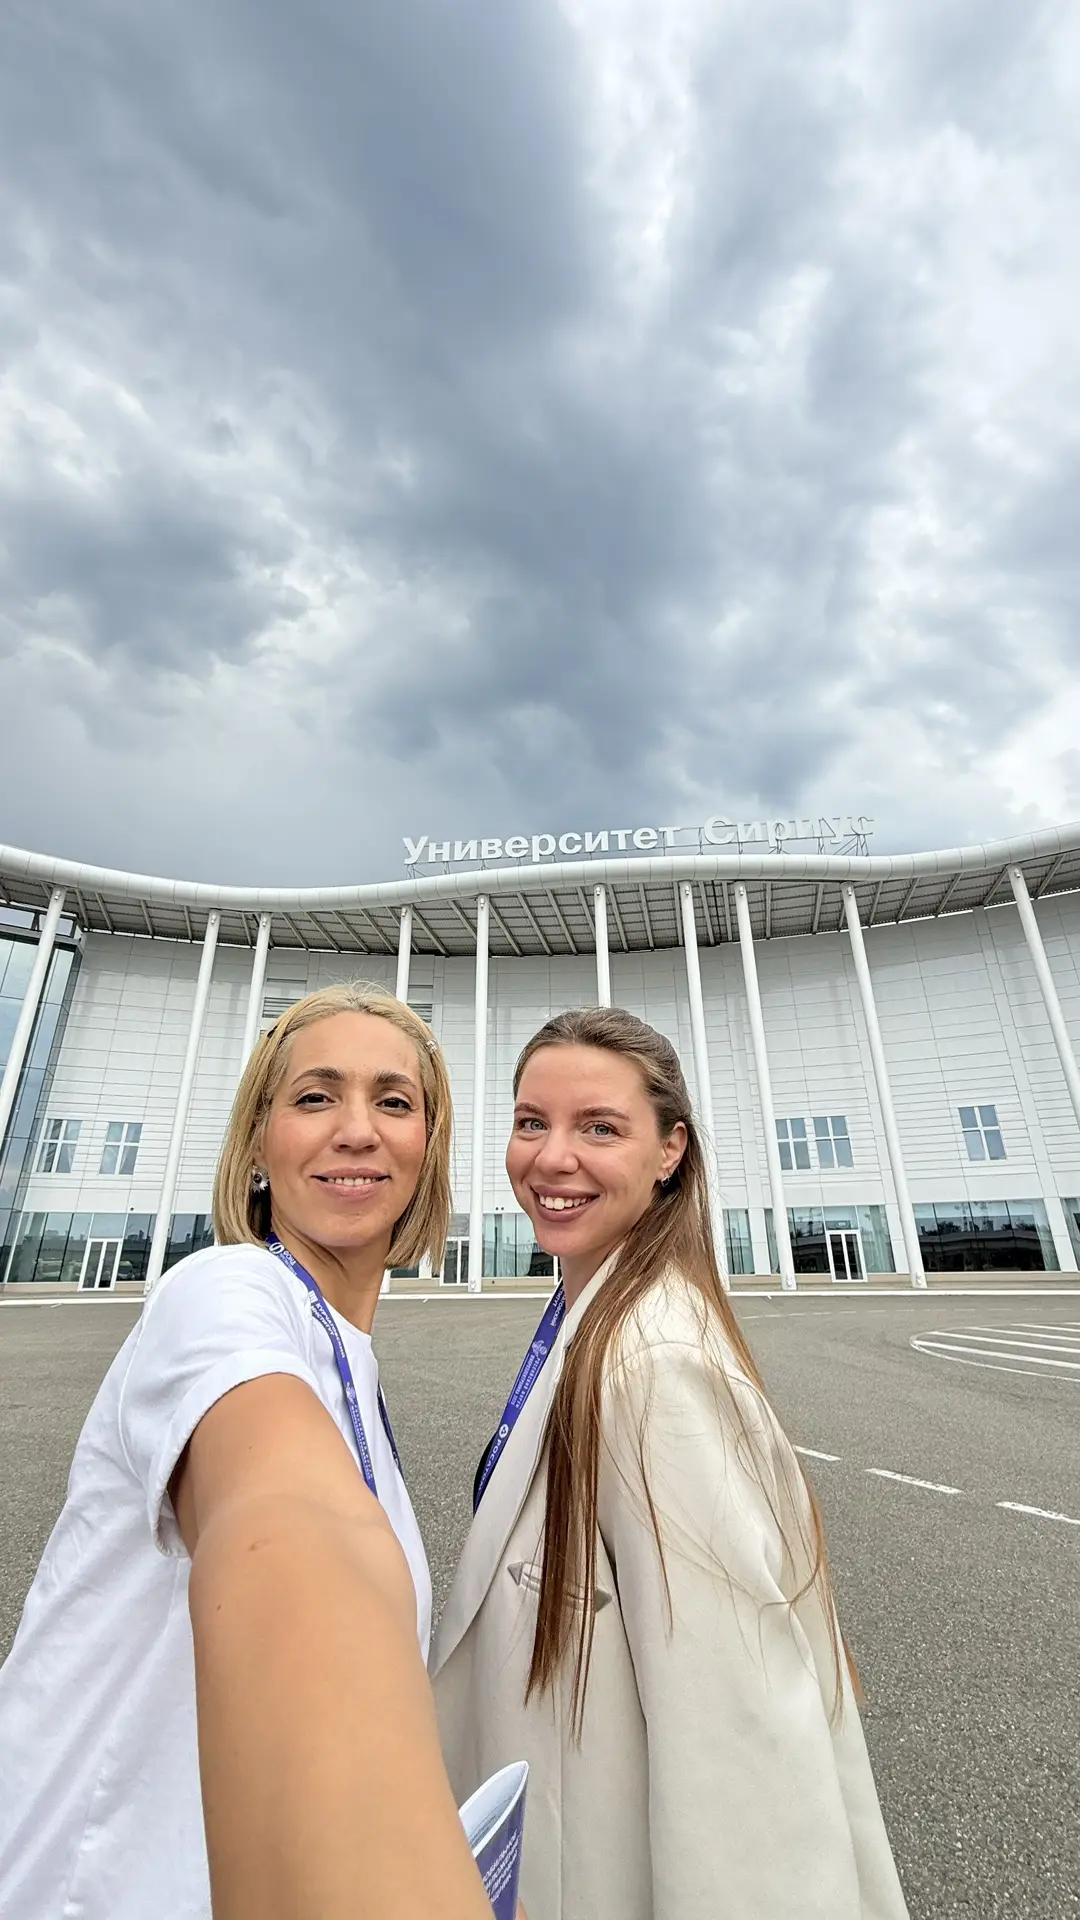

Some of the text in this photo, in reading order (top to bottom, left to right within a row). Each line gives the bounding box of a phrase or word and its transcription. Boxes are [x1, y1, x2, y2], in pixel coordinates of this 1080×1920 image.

[402, 815, 875, 864] Университет Сириус
[478, 1438, 502, 1491] РОСАТОМ
